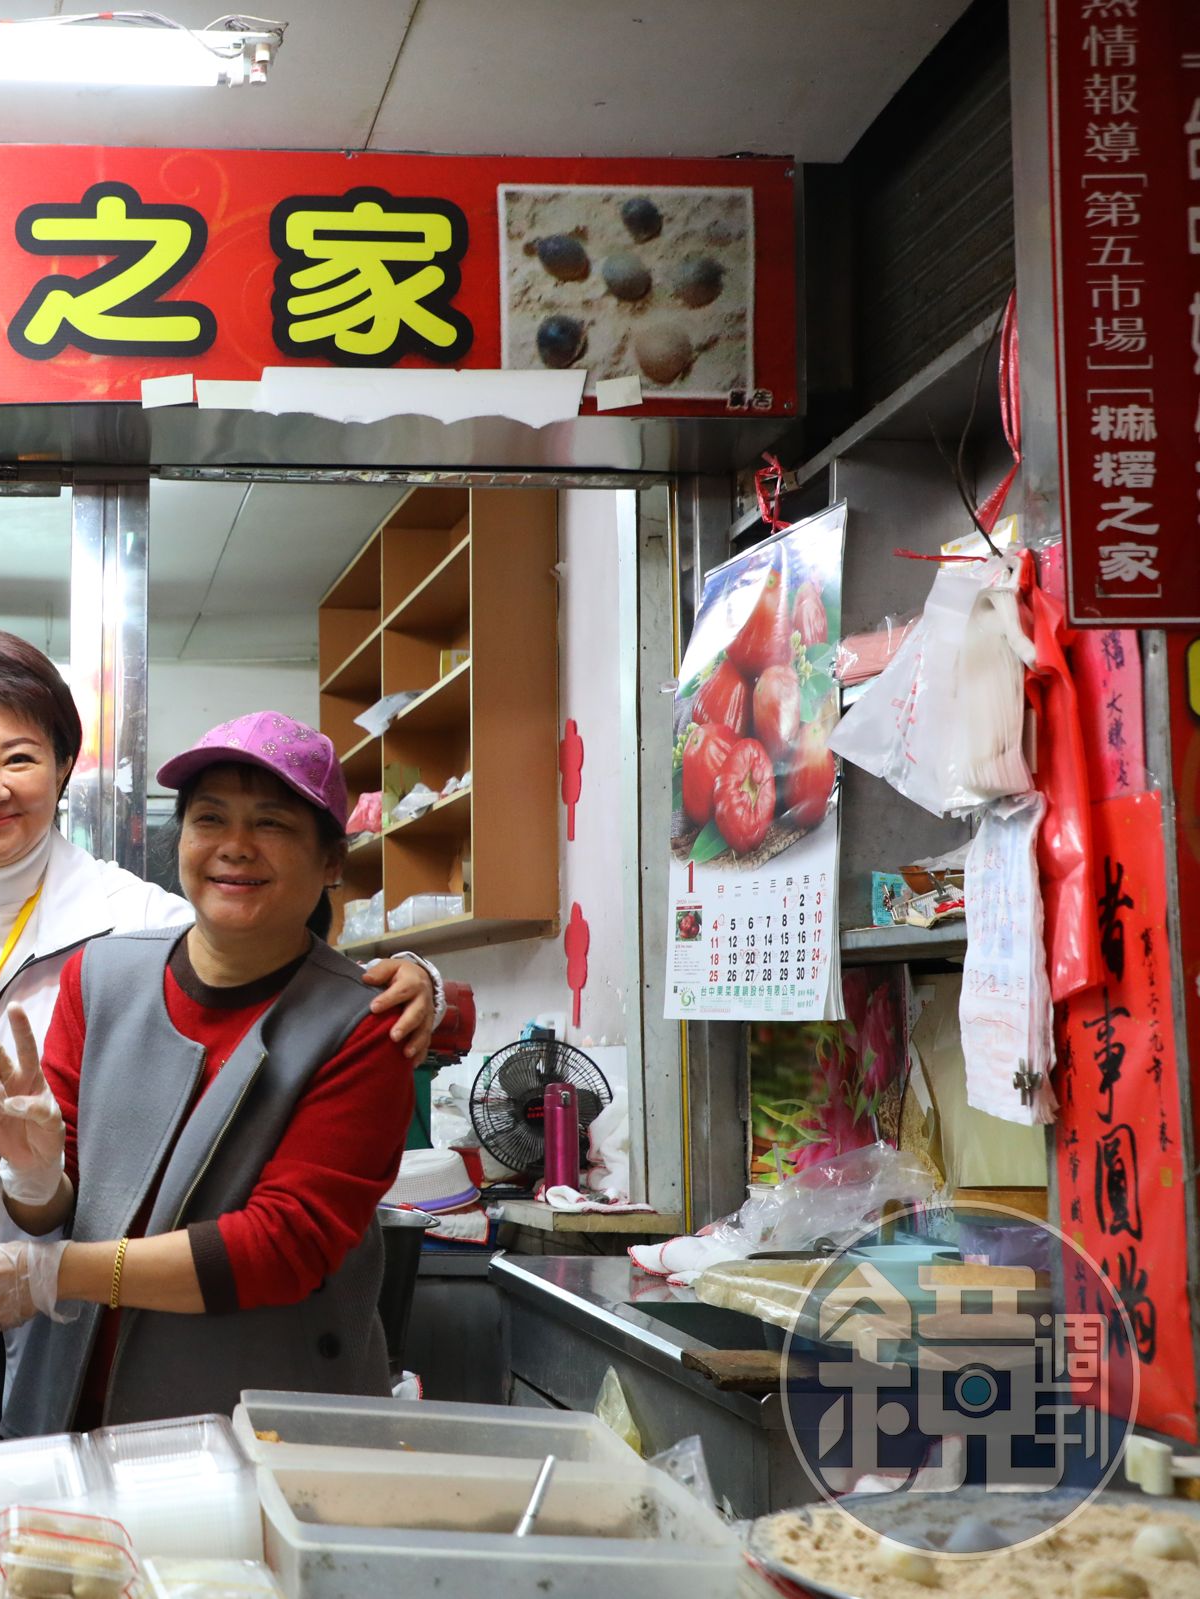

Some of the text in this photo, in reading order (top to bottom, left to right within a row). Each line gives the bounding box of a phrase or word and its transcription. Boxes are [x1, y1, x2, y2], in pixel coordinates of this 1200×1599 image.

[684, 860, 695, 893] 1
[782, 892, 821, 908] 1 2 3
[712, 910, 822, 931] 4 5 6 7 8 9 10
[710, 929, 821, 949] 11 12 13 14 15 16 17
[710, 948, 820, 966] 18 19 20 21 22 23 24
[709, 966, 819, 983] 25 26 27 28 29 30 31
